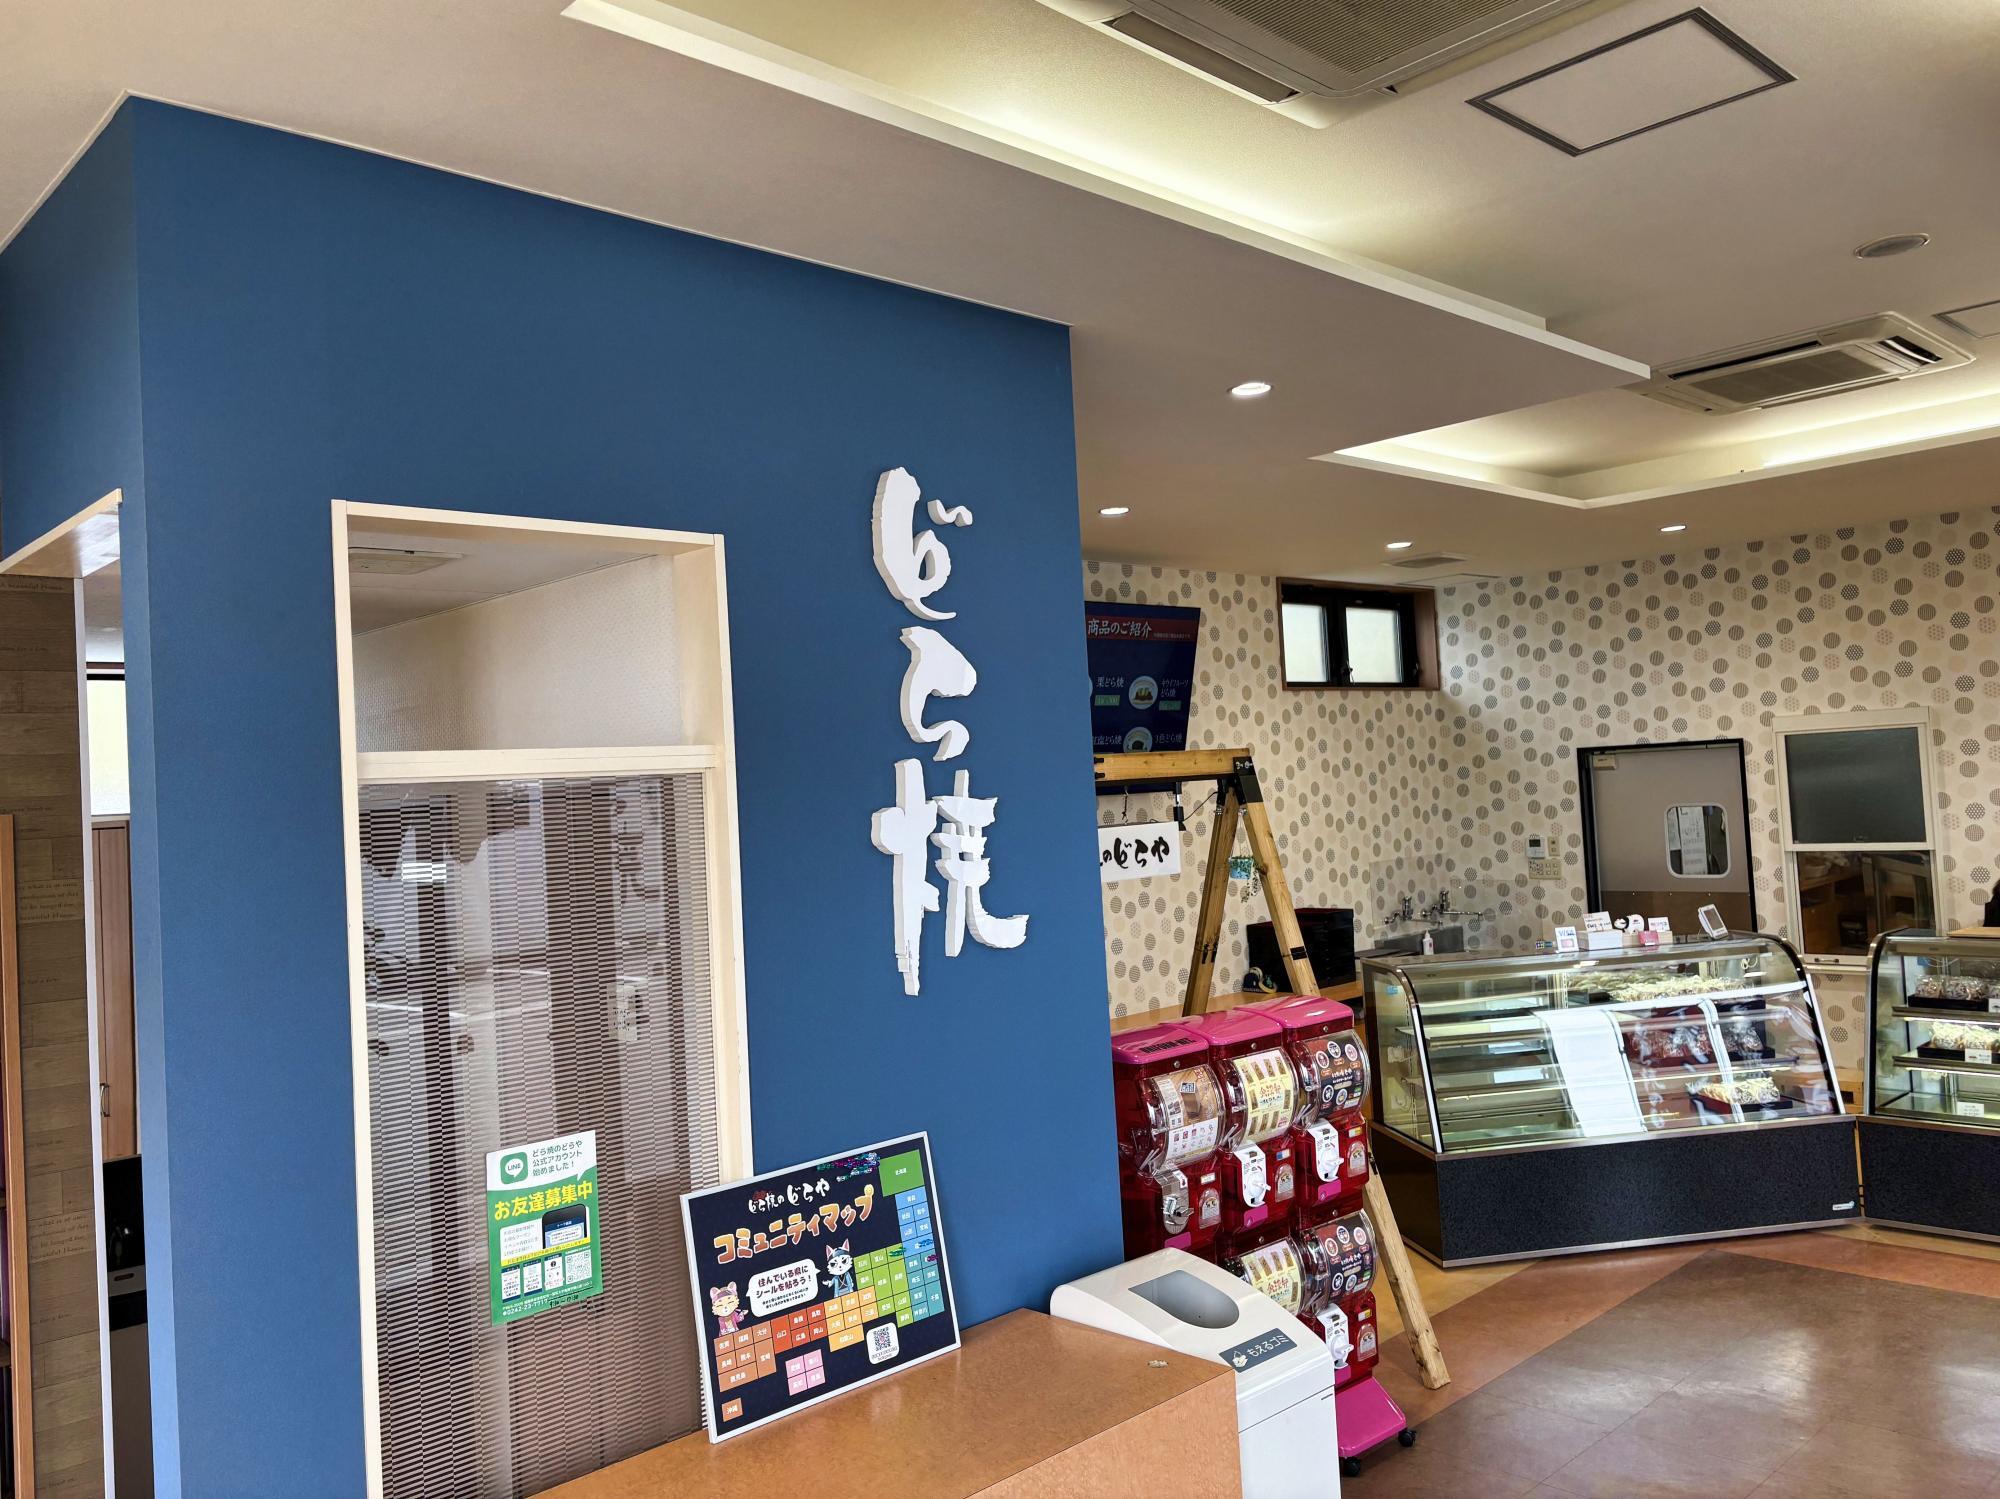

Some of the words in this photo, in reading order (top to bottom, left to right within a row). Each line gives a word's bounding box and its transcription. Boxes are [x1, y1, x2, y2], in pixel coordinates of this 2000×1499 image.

[1087, 617, 1152, 638] 商品のご紹介
[1100, 836, 1170, 869] のどらや
[507, 1163, 521, 1171] LINE
[532, 1150, 583, 1168] 公式アカウント
[494, 1180, 593, 1220] お友達募集中
[713, 1184, 875, 1265] コミュニティマップ
[758, 1265, 809, 1288] 住んでいる県に
[1247, 1335, 1289, 1357] もえるゴミ
